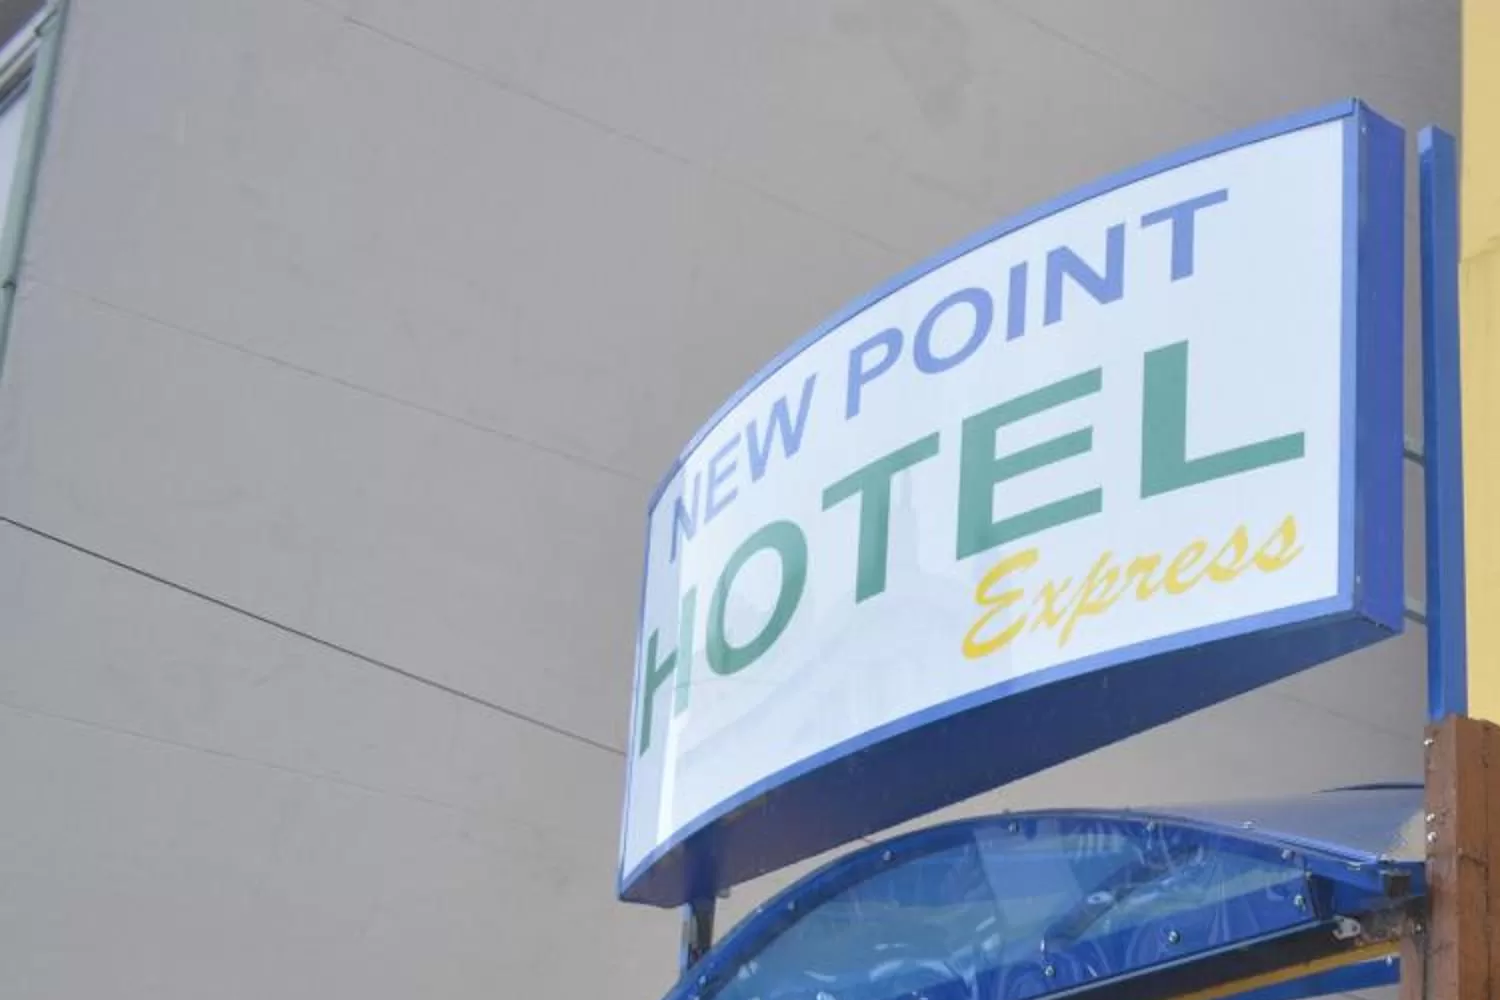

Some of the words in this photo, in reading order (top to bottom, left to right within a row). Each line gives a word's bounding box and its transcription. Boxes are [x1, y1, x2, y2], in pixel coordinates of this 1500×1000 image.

[639, 339, 1305, 758] HOTEL
[670, 373, 816, 561] NEW
[845, 187, 1228, 421] POINT
[961, 513, 1304, 660] Express
